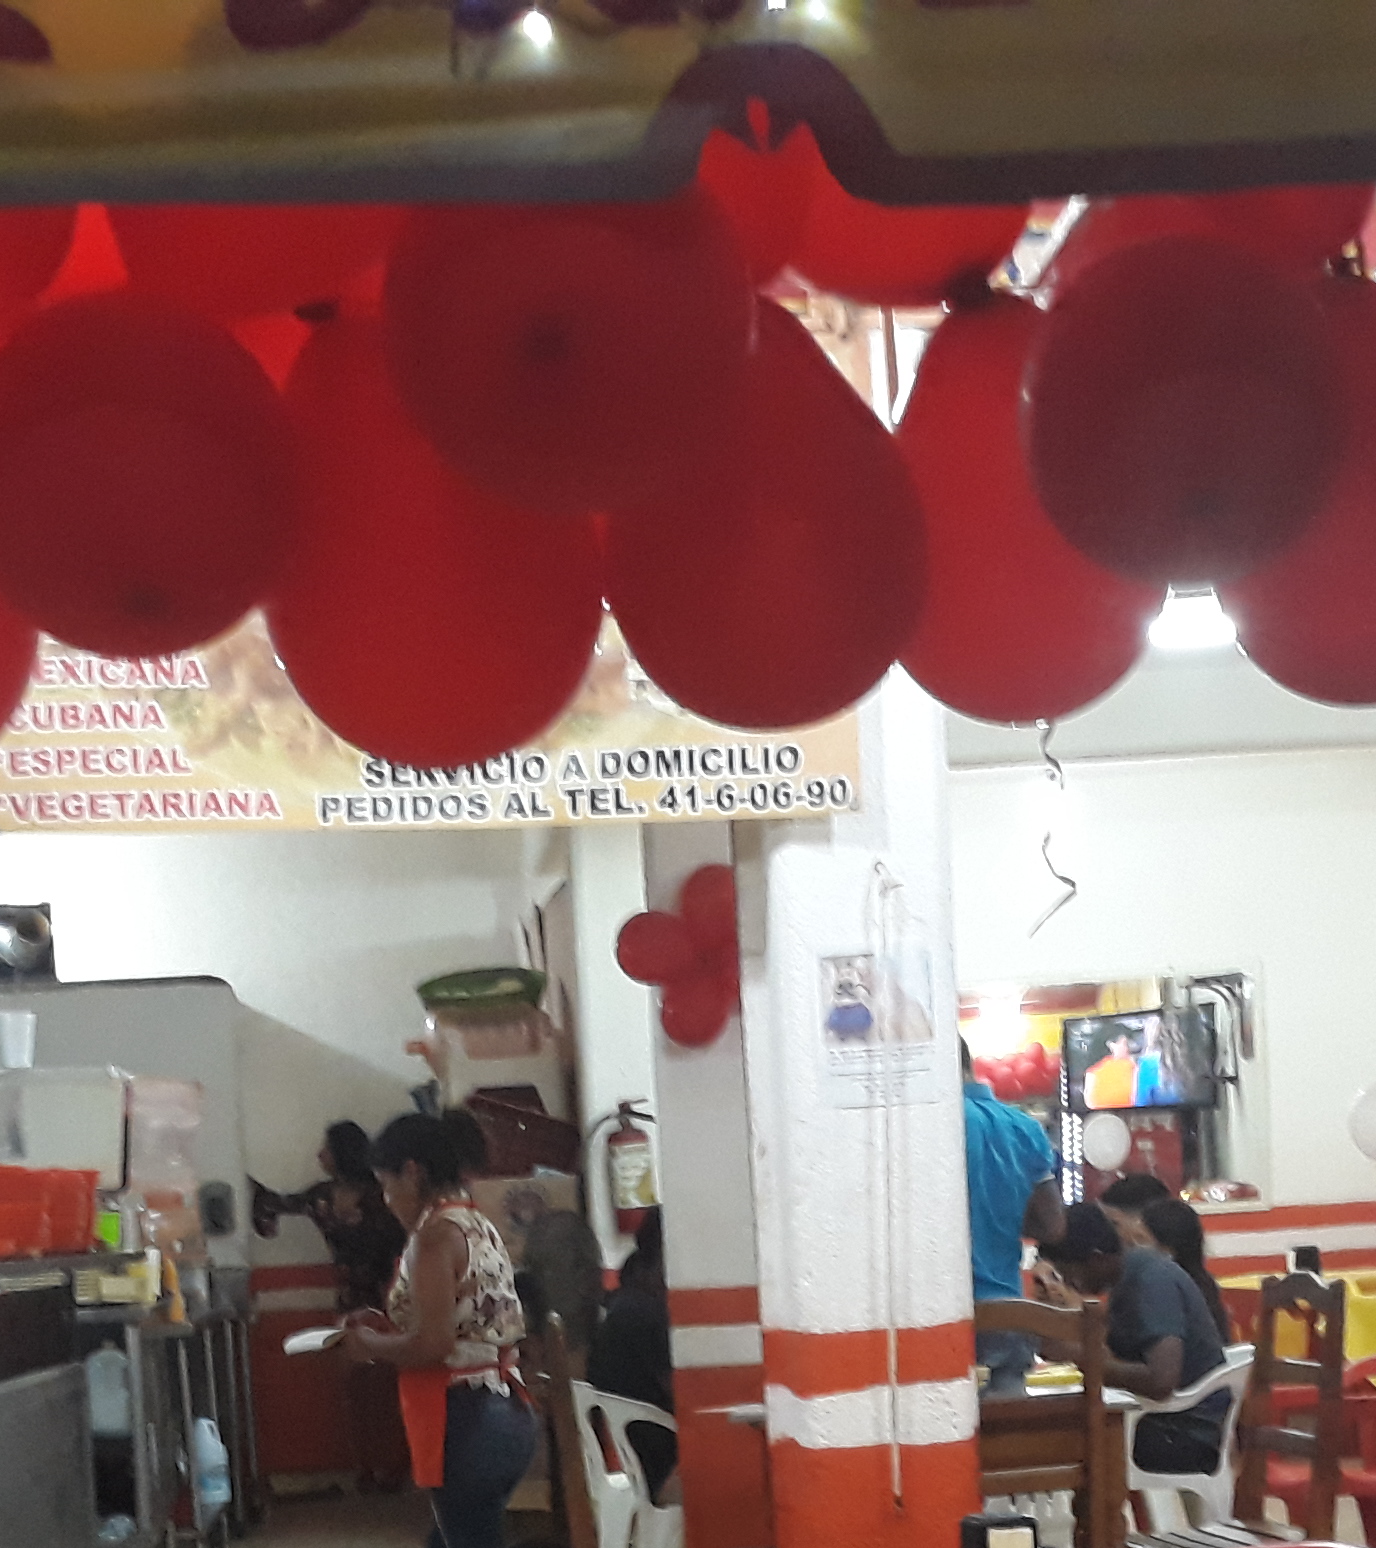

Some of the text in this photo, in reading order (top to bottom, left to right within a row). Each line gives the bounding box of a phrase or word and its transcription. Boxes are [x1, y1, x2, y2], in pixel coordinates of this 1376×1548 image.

[32, 656, 207, 687] EXICANA
[10, 748, 191, 778] ESPECIAL
[562, 752, 588, 782] A
[601, 746, 800, 780] DOMICILIO
[9, 792, 281, 821] VEGETARIANA
[321, 778, 848, 824] PEDIDOS AL TEL. 41-6-06-90
